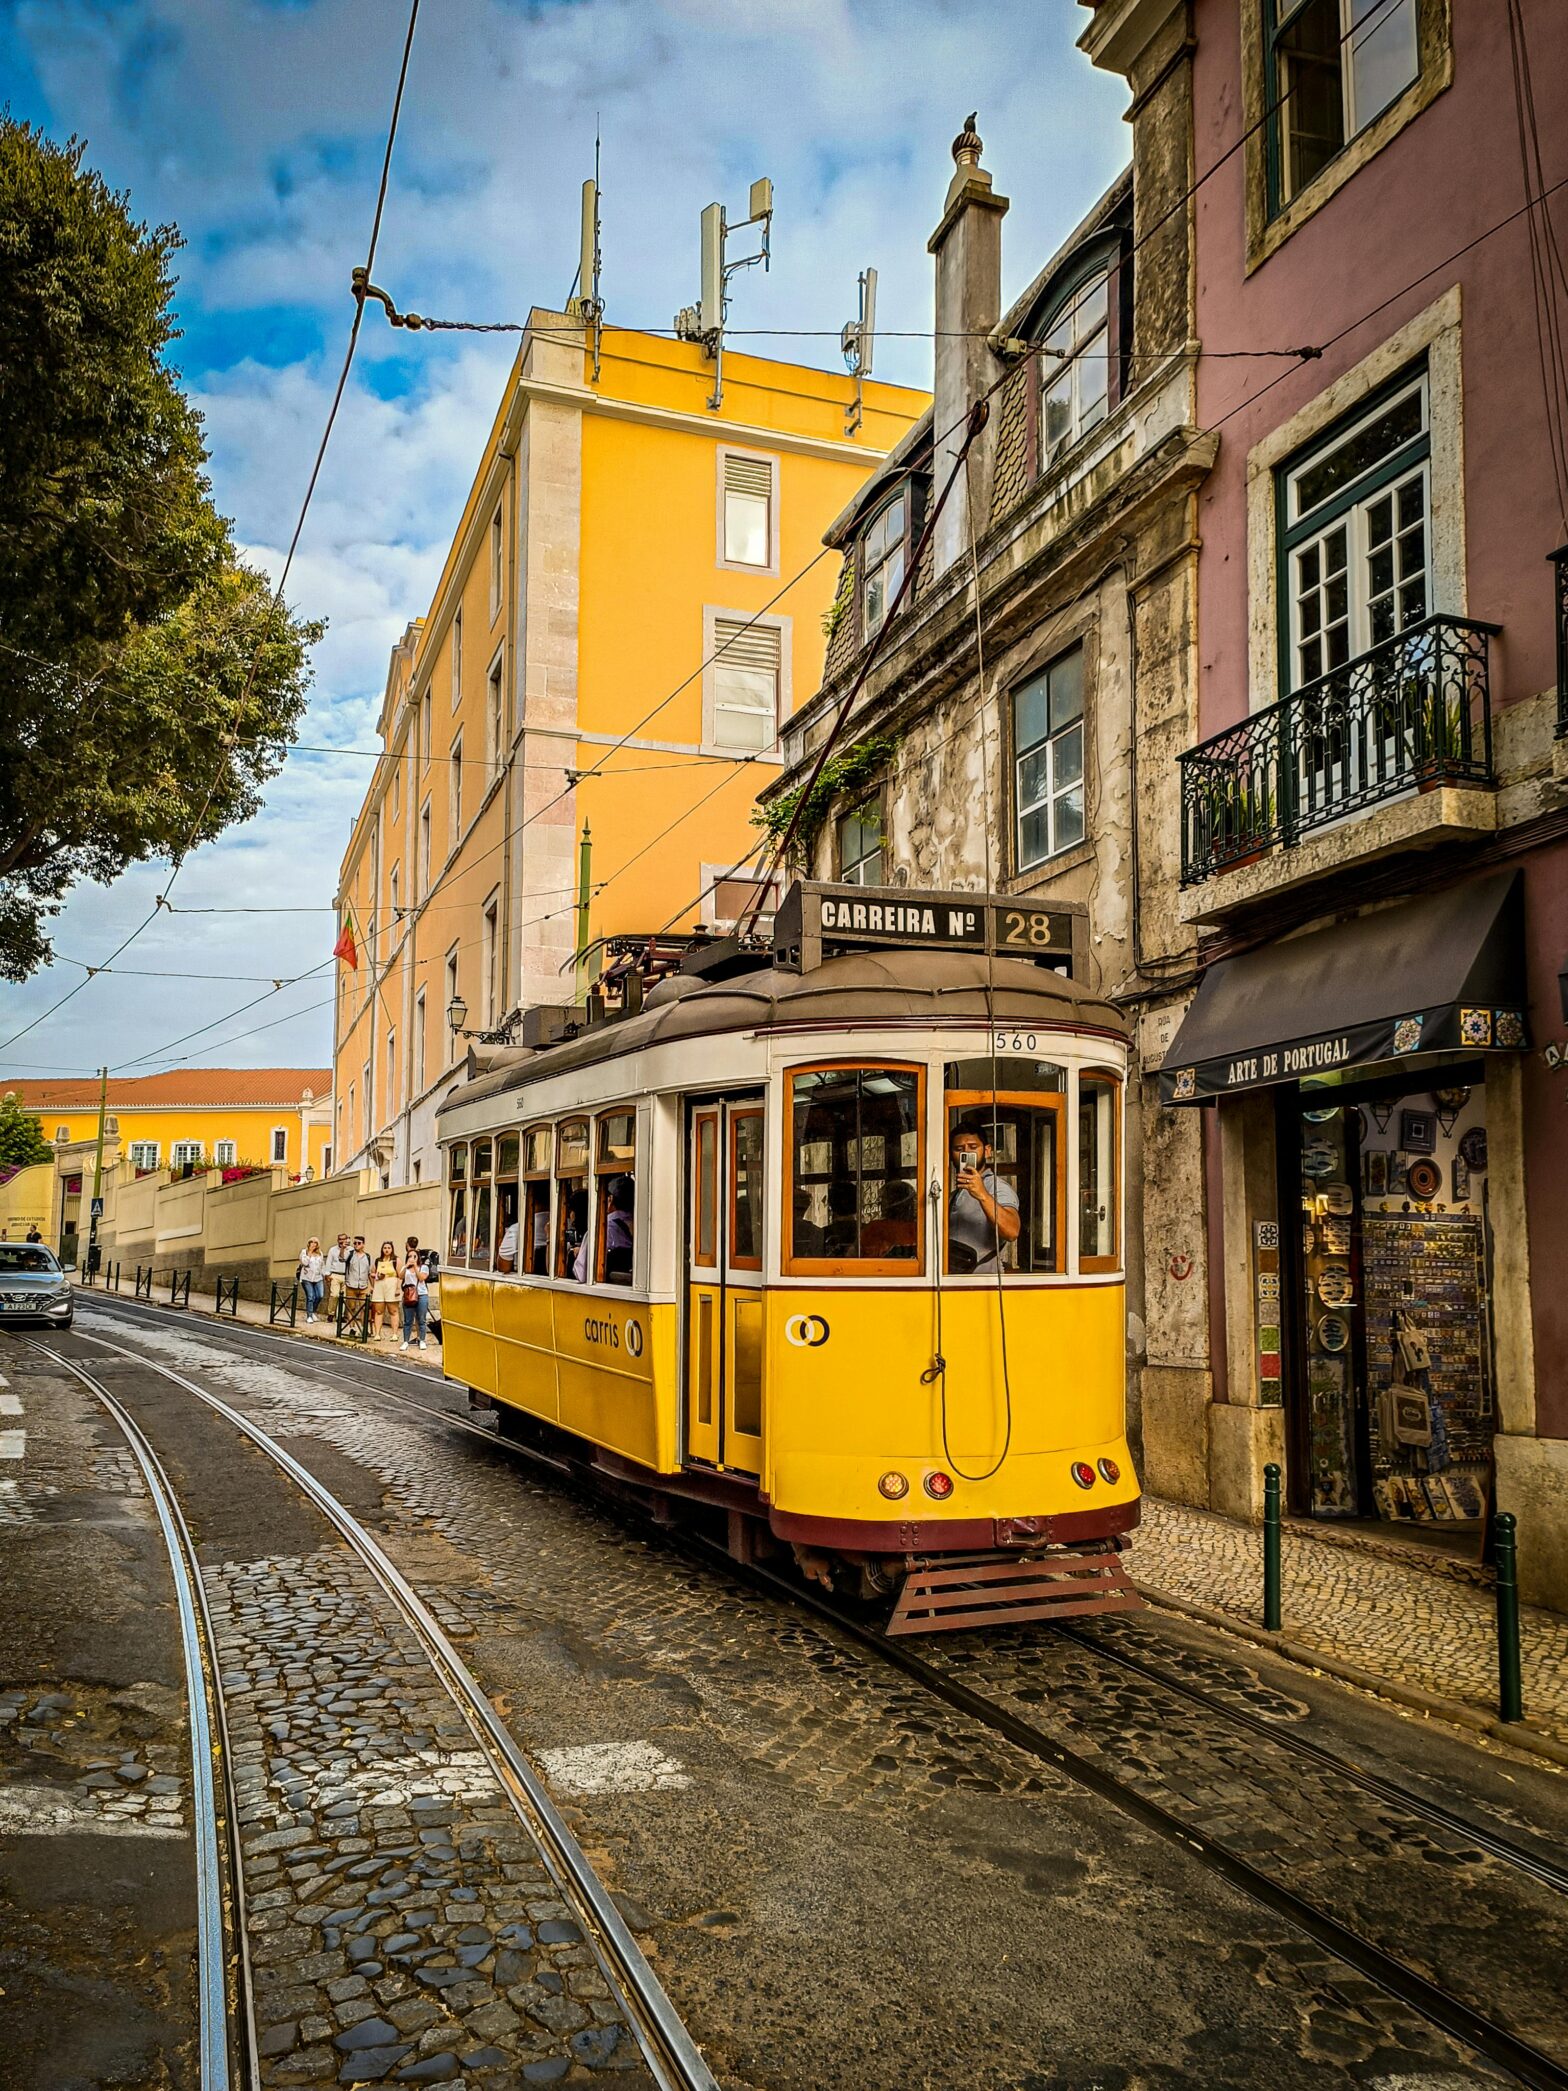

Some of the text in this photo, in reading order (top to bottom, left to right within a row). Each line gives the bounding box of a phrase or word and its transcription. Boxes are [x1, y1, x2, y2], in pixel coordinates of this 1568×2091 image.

[821, 901, 936, 935] CARREIRA
[1005, 912, 1051, 946] 28
[996, 1032, 1037, 1051] 560
[1160, 1032, 1169, 1043] DE
[1227, 1038, 1350, 1084] ARTE DE PORTUGAL
[584, 1312, 620, 1348] carris
